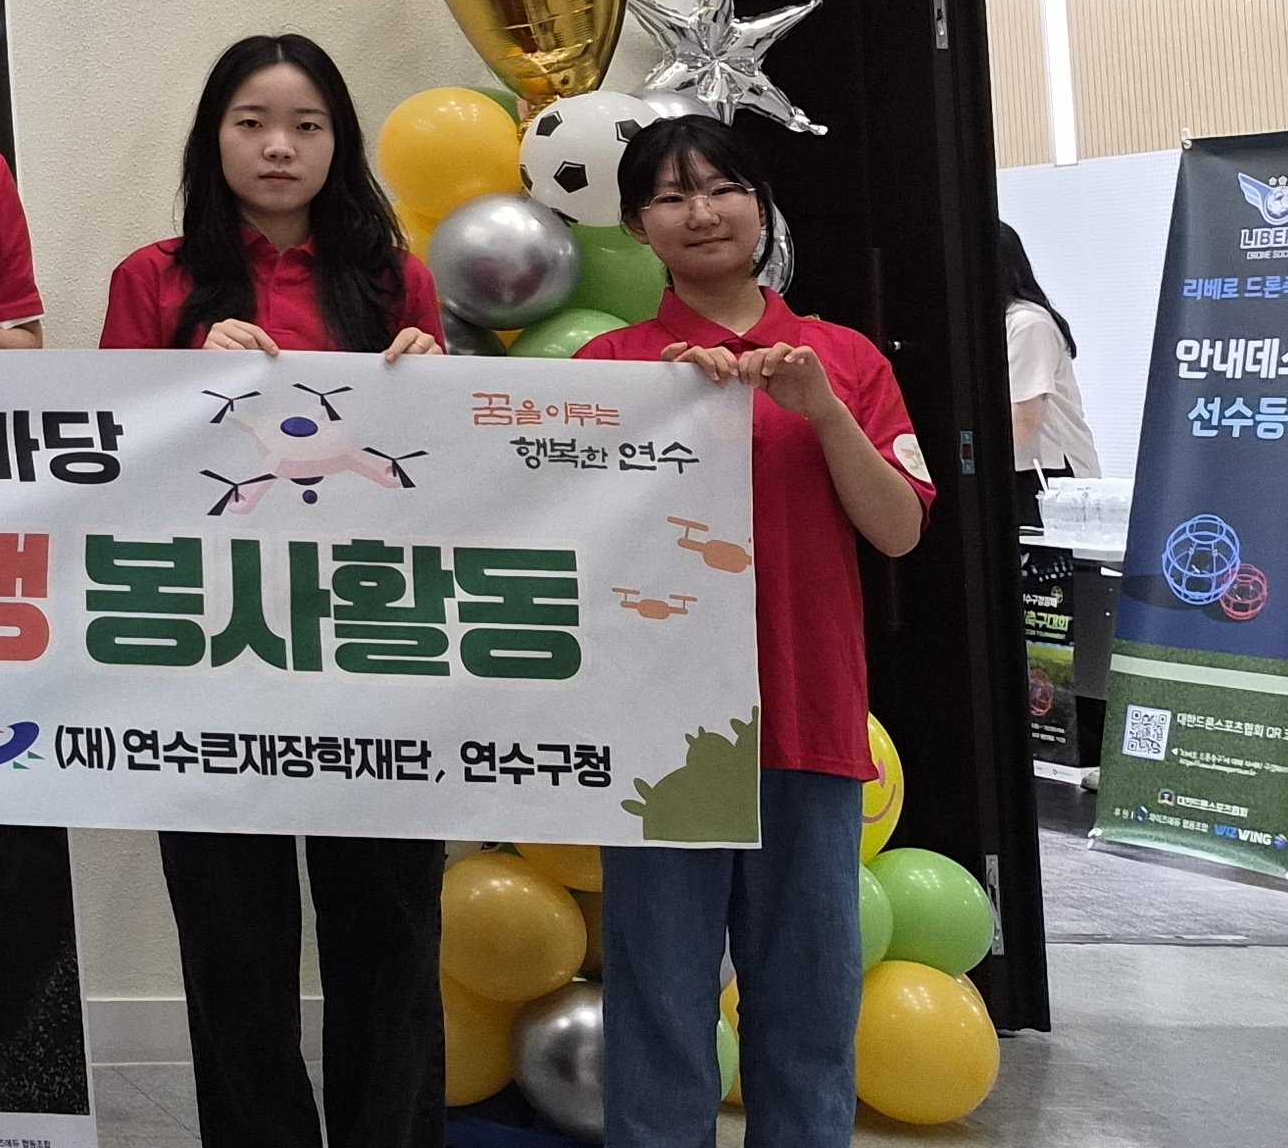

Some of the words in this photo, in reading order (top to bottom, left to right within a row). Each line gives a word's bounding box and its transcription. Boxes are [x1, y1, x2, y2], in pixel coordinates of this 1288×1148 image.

[1183, 277, 1239, 300] 리베로
[1244, 275, 1288, 299] 드론
[1176, 338, 1288, 379] 안내데
[510, 436, 608, 470] 행복한
[618, 442, 700, 474] 연수
[84, 534, 582, 680] 봉사활동
[1266, 726, 1282, 739] QR
[460, 741, 612, 788] 연수구청
